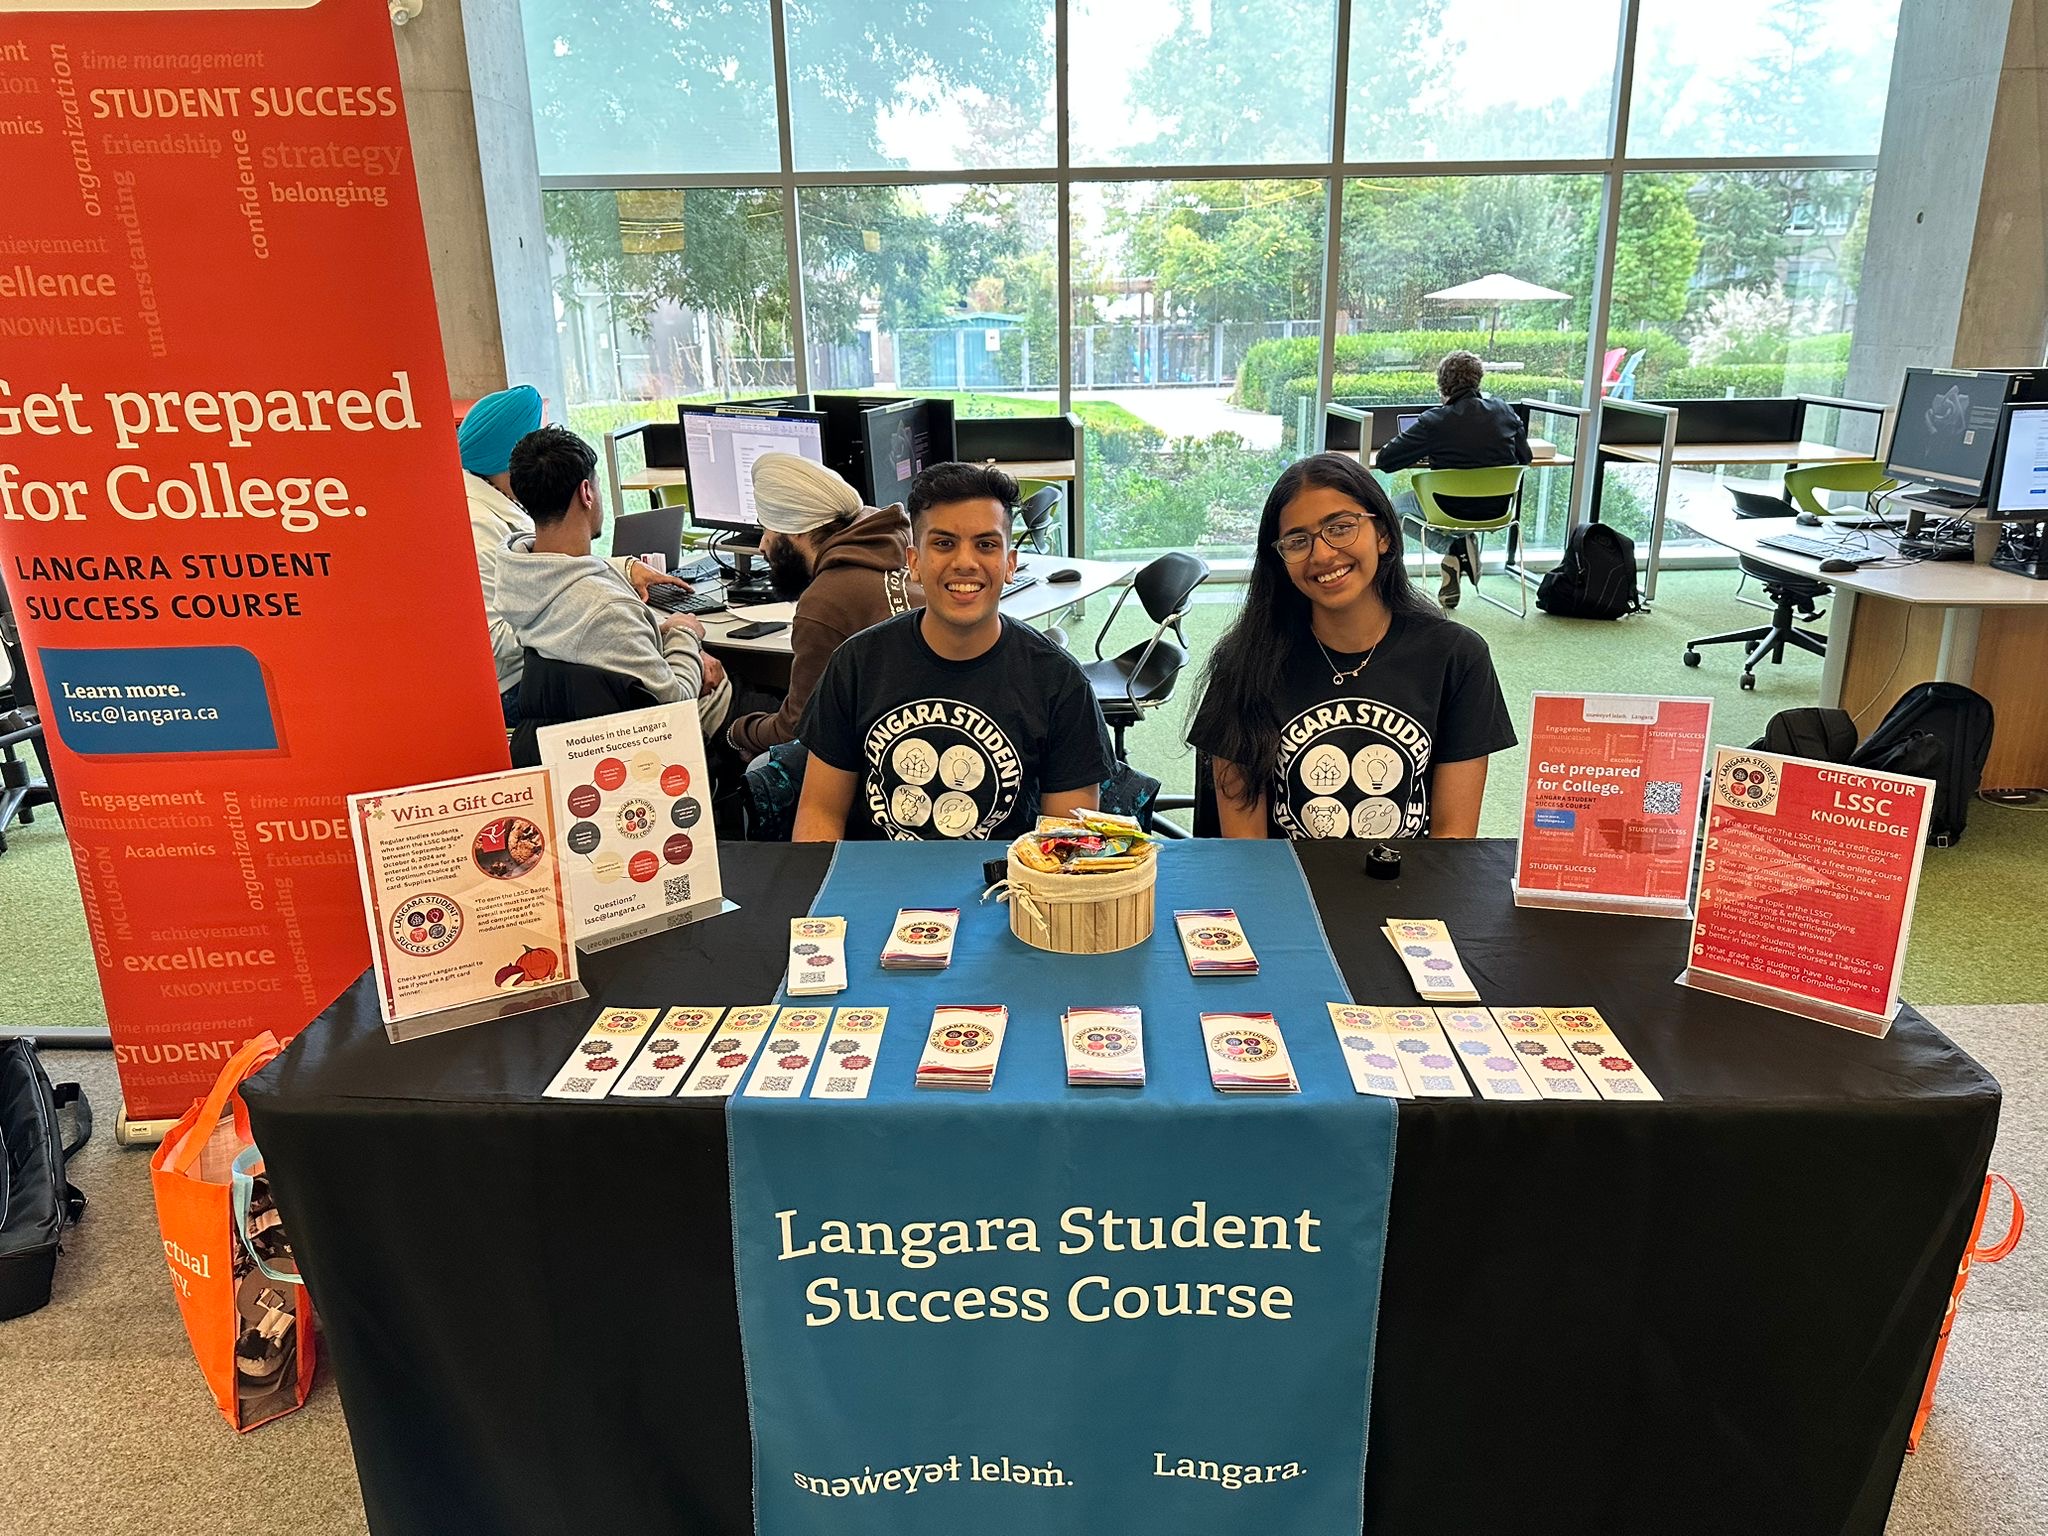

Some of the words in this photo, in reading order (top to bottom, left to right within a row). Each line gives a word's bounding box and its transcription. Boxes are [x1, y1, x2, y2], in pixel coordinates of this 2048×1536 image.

[81, 51, 128, 70] time
[134, 50, 264, 73] management
[89, 87, 240, 118] STUDENT
[251, 86, 398, 118] SUCCESS
[50, 43, 102, 217] organization
[101, 134, 222, 159] friendship
[262, 141, 402, 176] strategy
[231, 129, 269, 260] confidence
[270, 181, 388, 207] belonging
[112, 169, 167, 358] understanding
[105, 371, 422, 449] prepared
[0, 463, 88, 522] for
[106, 462, 367, 532] College.
[15, 554, 172, 581] LANGARA
[181, 553, 333, 579] STUDENT
[25, 595, 159, 620] SUCCESS
[171, 593, 302, 618] COURSE
[61, 682, 122, 700] Learn
[125, 681, 187, 699] more.
[69, 705, 218, 725] lssc@langara.ca
[565, 732, 604, 747] Modules
[605, 730, 614, 738] in
[615, 727, 630, 736] the
[632, 719, 666, 735] Langara
[1533, 733, 1591, 741] communication
[1546, 725, 1590, 733] Engagement
[567, 744, 604, 760] Student
[605, 737, 640, 752] Success
[642, 731, 672, 744] Course
[866, 703, 947, 766] LANGARA
[951, 706, 1020, 788] STUDENT
[1548, 746, 1603, 755] KNOWLEDGE
[1538, 761, 1565, 773] Get
[1569, 762, 1640, 780] prepared
[1720, 756, 1751, 777] LANGARA
[1752, 758, 1778, 786] STUDENT
[1817, 768, 1867, 788] CHECK
[1870, 778, 1916, 797] YOUR
[1536, 777, 1558, 790] for
[1562, 779, 1624, 796] College.
[1719, 783, 1745, 808] SUCCESS
[1746, 792, 1775, 808] COURSE
[80, 790, 205, 811] Engagement
[250, 794, 288, 808] time
[392, 803, 433, 822] Win
[438, 804, 448, 814] a
[452, 795, 486, 812] Gift
[491, 787, 532, 806] Card
[1833, 790, 1892, 817] LSSC
[256, 818, 350, 843] STUDE
[379, 836, 404, 846] Regular
[406, 832, 428, 841] studies
[430, 827, 458, 836] students
[1811, 809, 1909, 837] KNOWLEDGE
[125, 843, 216, 858] Academics
[223, 791, 264, 911] organization
[266, 849, 354, 867] friendshi
[383, 858, 409, 868] October
[1588, 851, 1623, 859] excellence
[384, 866, 409, 875] entered
[1529, 862, 1563, 870] STUDENT
[1564, 864, 1596, 872] SUCCESS
[71, 840, 113, 968] community
[95, 845, 133, 941] INCLUSION
[593, 893, 636, 912] Questions?
[393, 897, 424, 929] LANGARA
[425, 895, 458, 917] STUDENT
[584, 901, 645, 926] lssc@langara.ca
[150, 923, 269, 941] achievement
[274, 877, 317, 1006] understanding
[396, 935, 431, 953] SUCCESS
[432, 925, 460, 952] COURSE
[1696, 922, 1707, 936] 5
[1709, 922, 1726, 932] True
[1738, 929, 1759, 940] false?
[1761, 935, 1795, 949] Students
[1797, 944, 1814, 953] who
[1816, 948, 1833, 958] take
[1834, 953, 1849, 962] the
[1850, 957, 1871, 967] LSSC
[1872, 962, 1884, 970] do
[1708, 930, 1730, 940] better
[1741, 938, 1758, 947] their
[1760, 942, 1795, 956] academic
[1797, 953, 1827, 964] courses
[1838, 962, 1873, 977] Langara.
[123, 948, 275, 973] excellence
[1693, 942, 1704, 956] 6
[1706, 944, 1725, 954] What
[1728, 950, 1750, 961] grade
[1766, 959, 1799, 972] students
[1803, 968, 1822, 978] have
[1837, 976, 1868, 990] achieve
[1705, 952, 1732, 963] receive
[1732, 958, 1745, 966] the
[1746, 961, 1765, 971] LSSC
[1766, 966, 1789, 979] Badge
[1800, 975, 1850, 994] Completion?
[160, 978, 282, 998] KNOWLEDGE
[145, 1016, 254, 1034] management
[115, 1040, 235, 1064] STUDENT
[775, 1209, 1041, 1270] Langara
[1058, 1201, 1321, 1254] Student
[805, 1277, 1049, 1327] Success
[1068, 1275, 1294, 1323] Course
[1153, 1453, 1307, 1490] Langara.
